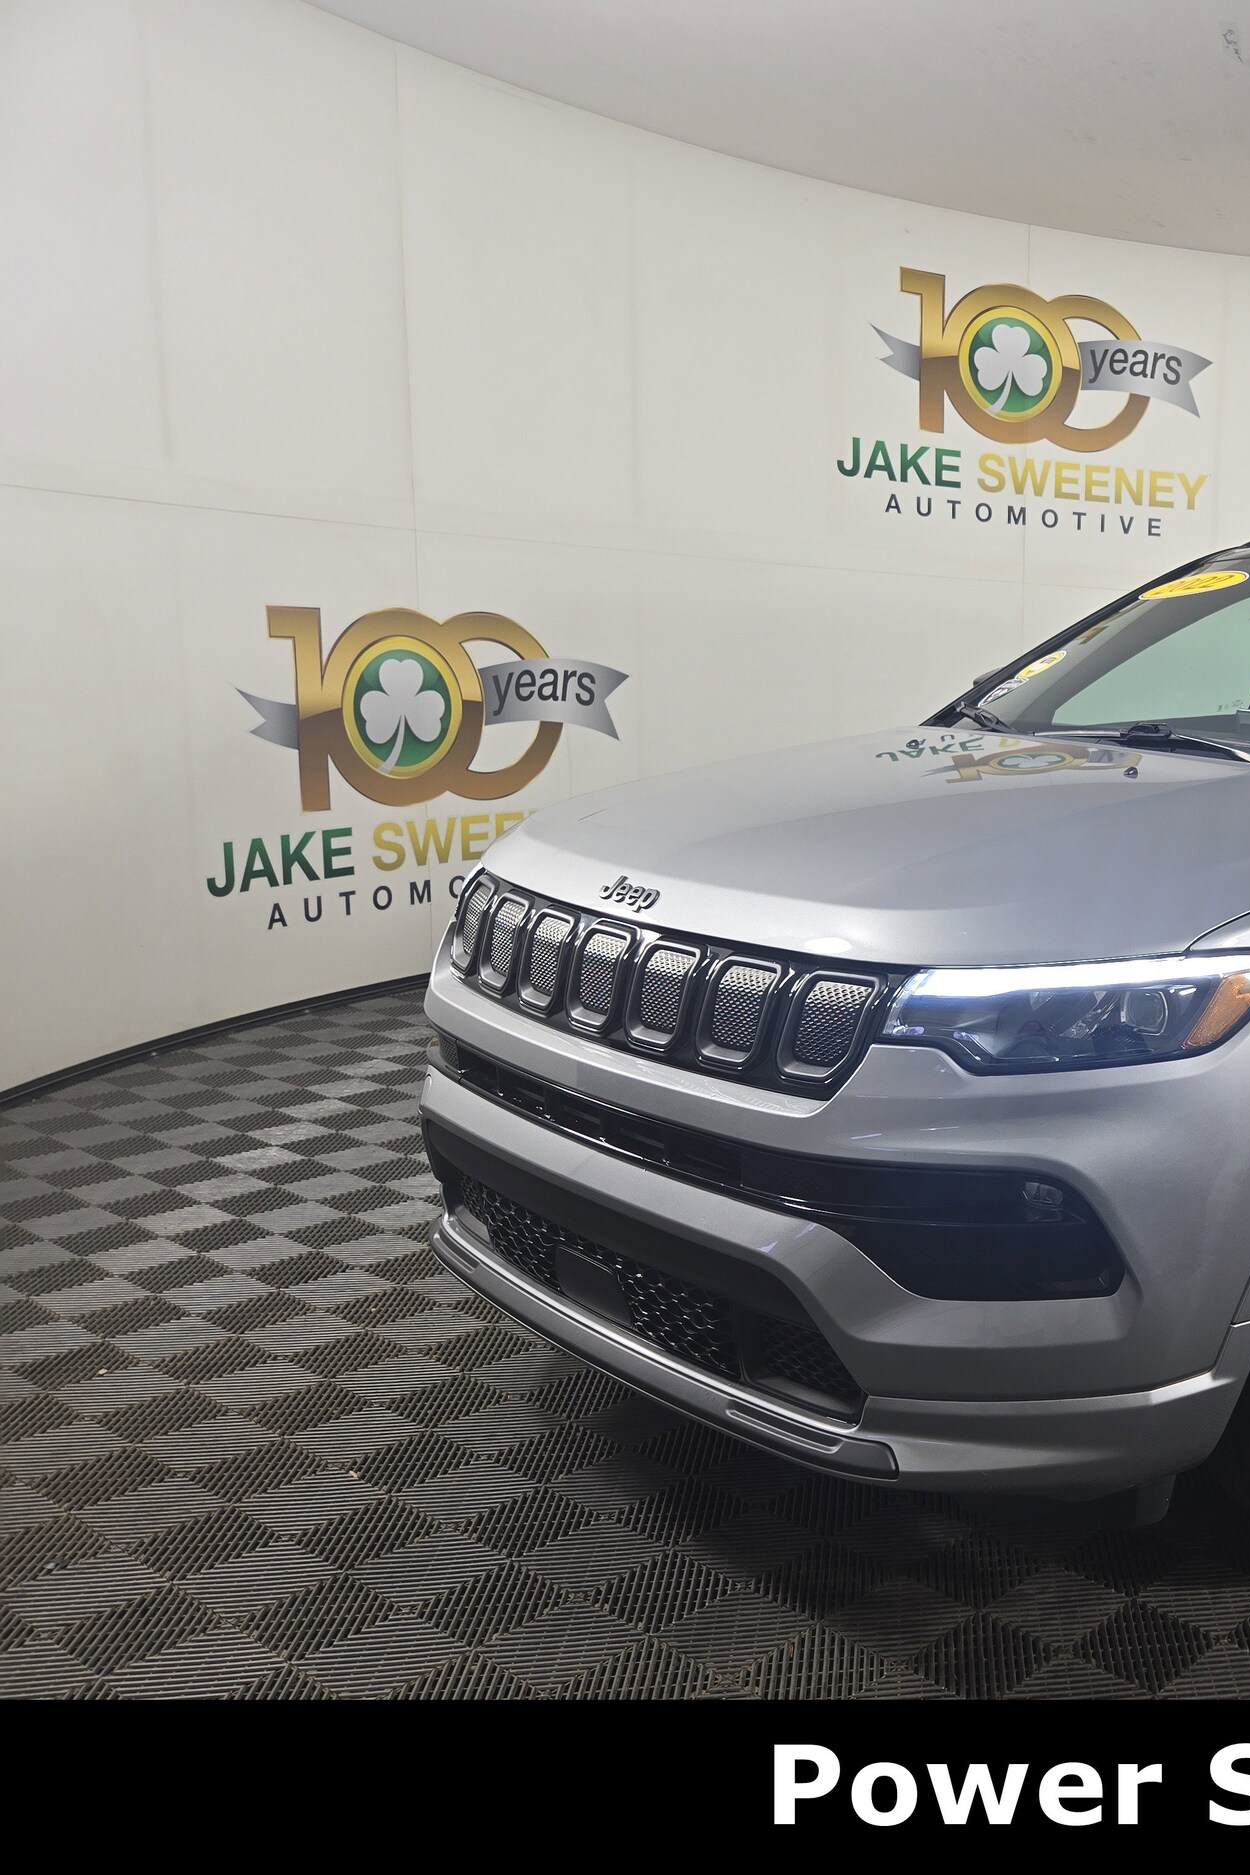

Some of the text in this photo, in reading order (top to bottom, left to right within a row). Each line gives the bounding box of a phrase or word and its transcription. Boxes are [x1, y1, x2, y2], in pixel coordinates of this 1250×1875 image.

[900, 266, 1151, 453] 100
[1088, 347, 1183, 386] years
[836, 436, 1208, 511] JAKE SWEENEY
[885, 493, 1162, 537] AUTOMOTIVE
[266, 605, 564, 813] 100
[492, 667, 596, 717] years
[206, 827, 355, 897] JAKE
[599, 875, 661, 913] Jeep
